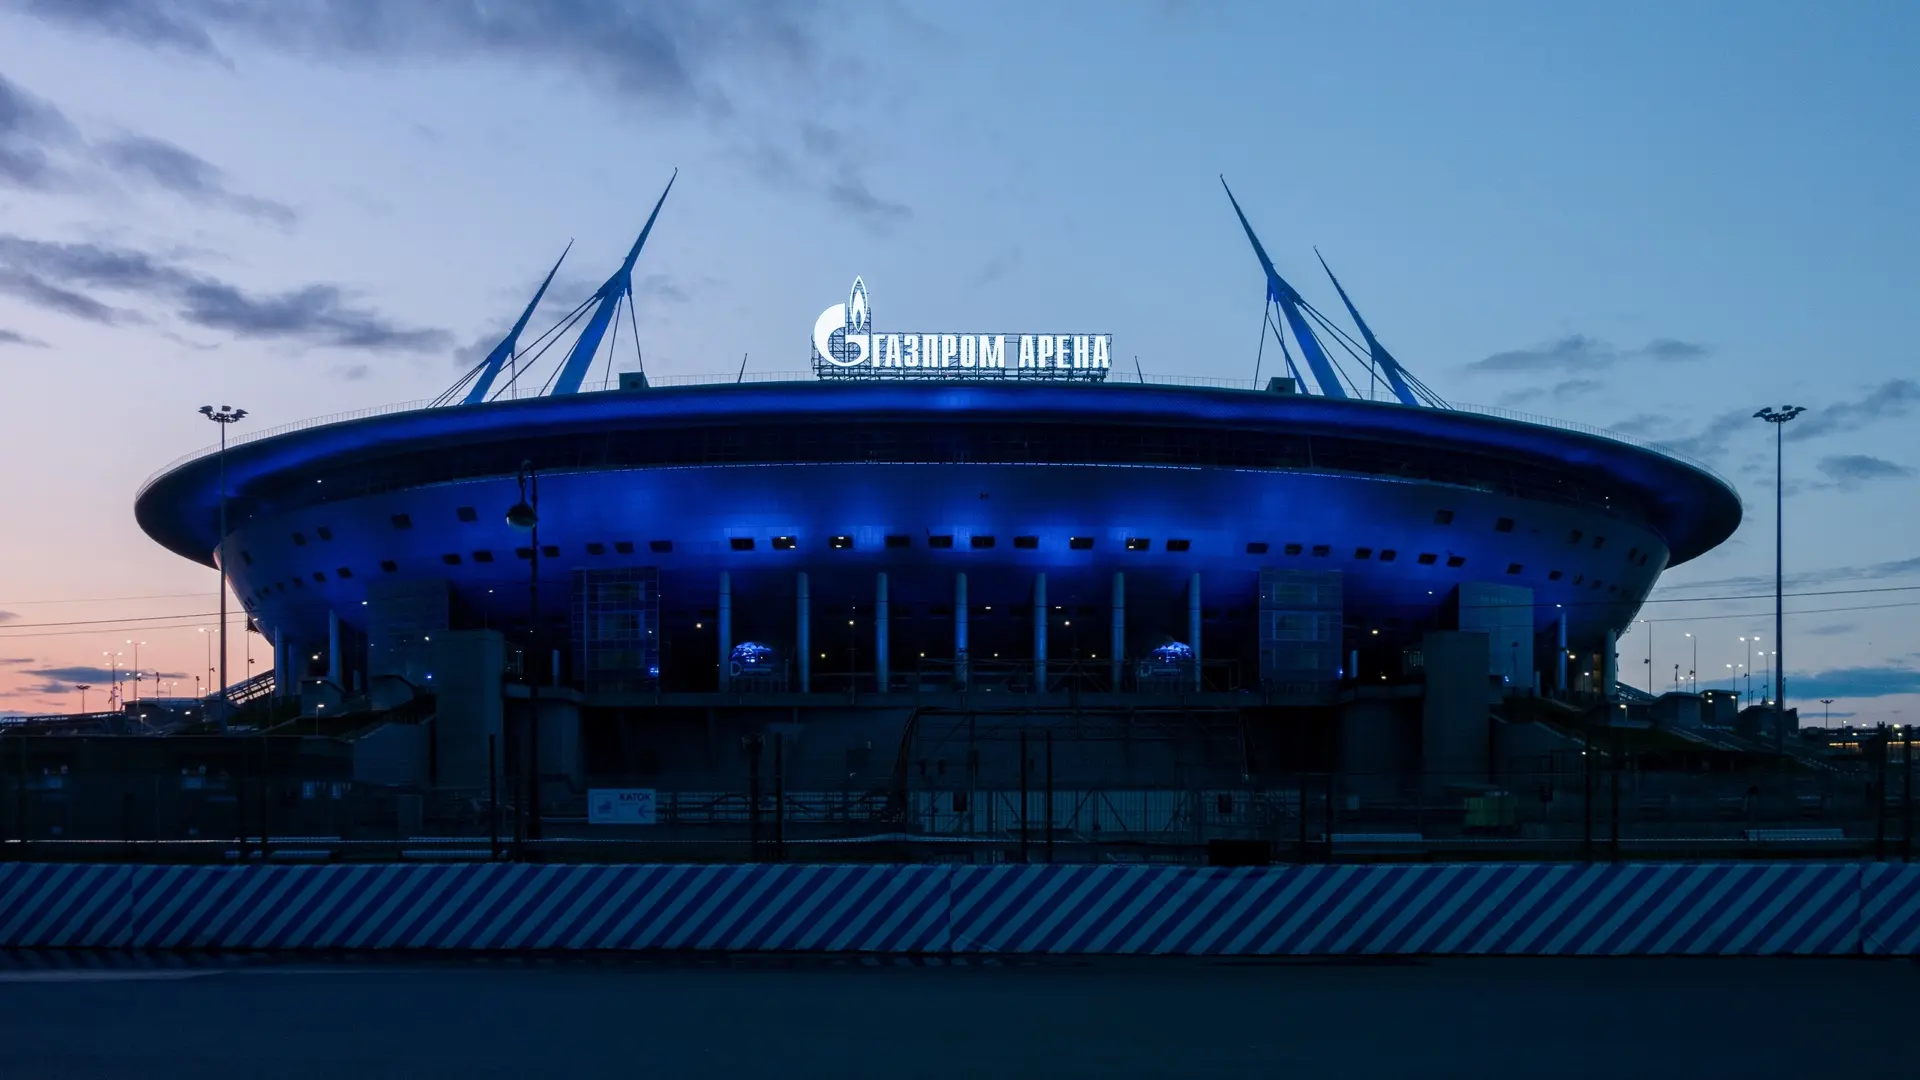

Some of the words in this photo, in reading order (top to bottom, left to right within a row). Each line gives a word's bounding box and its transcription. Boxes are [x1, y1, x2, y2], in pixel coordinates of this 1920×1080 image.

[872, 334, 1005, 368] ГАЗПРОМ
[1018, 334, 1109, 368] АРЕНА
[620, 792, 652, 801] КАТОК
